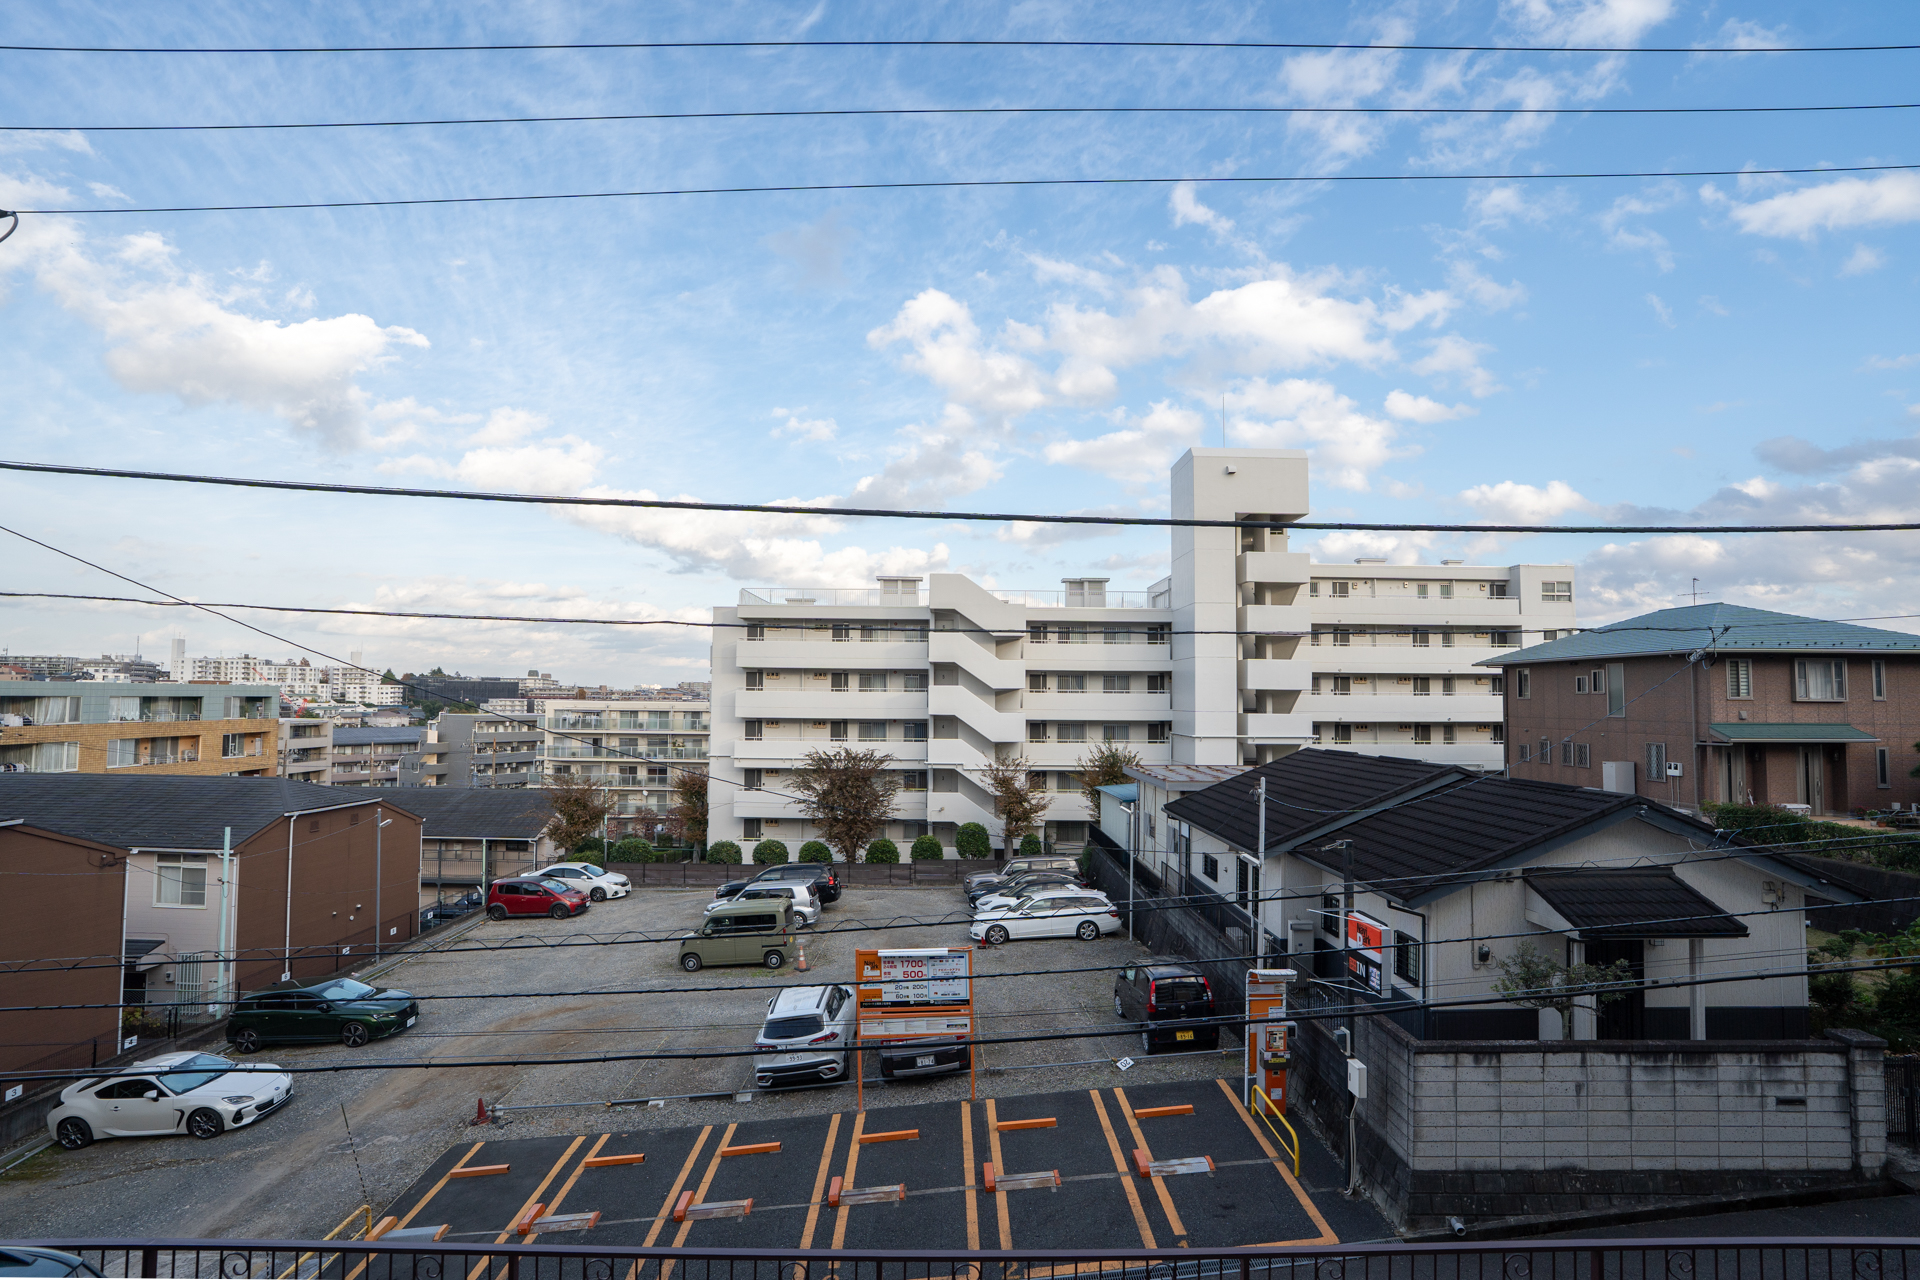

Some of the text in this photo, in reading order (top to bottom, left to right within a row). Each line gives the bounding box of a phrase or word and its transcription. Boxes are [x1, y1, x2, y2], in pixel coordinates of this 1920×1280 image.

[1357, 922, 1368, 937] Navi
[1357, 931, 1371, 949] Park
[1356, 960, 1366, 978] IN
[11, 1088, 17, 1097] 3
